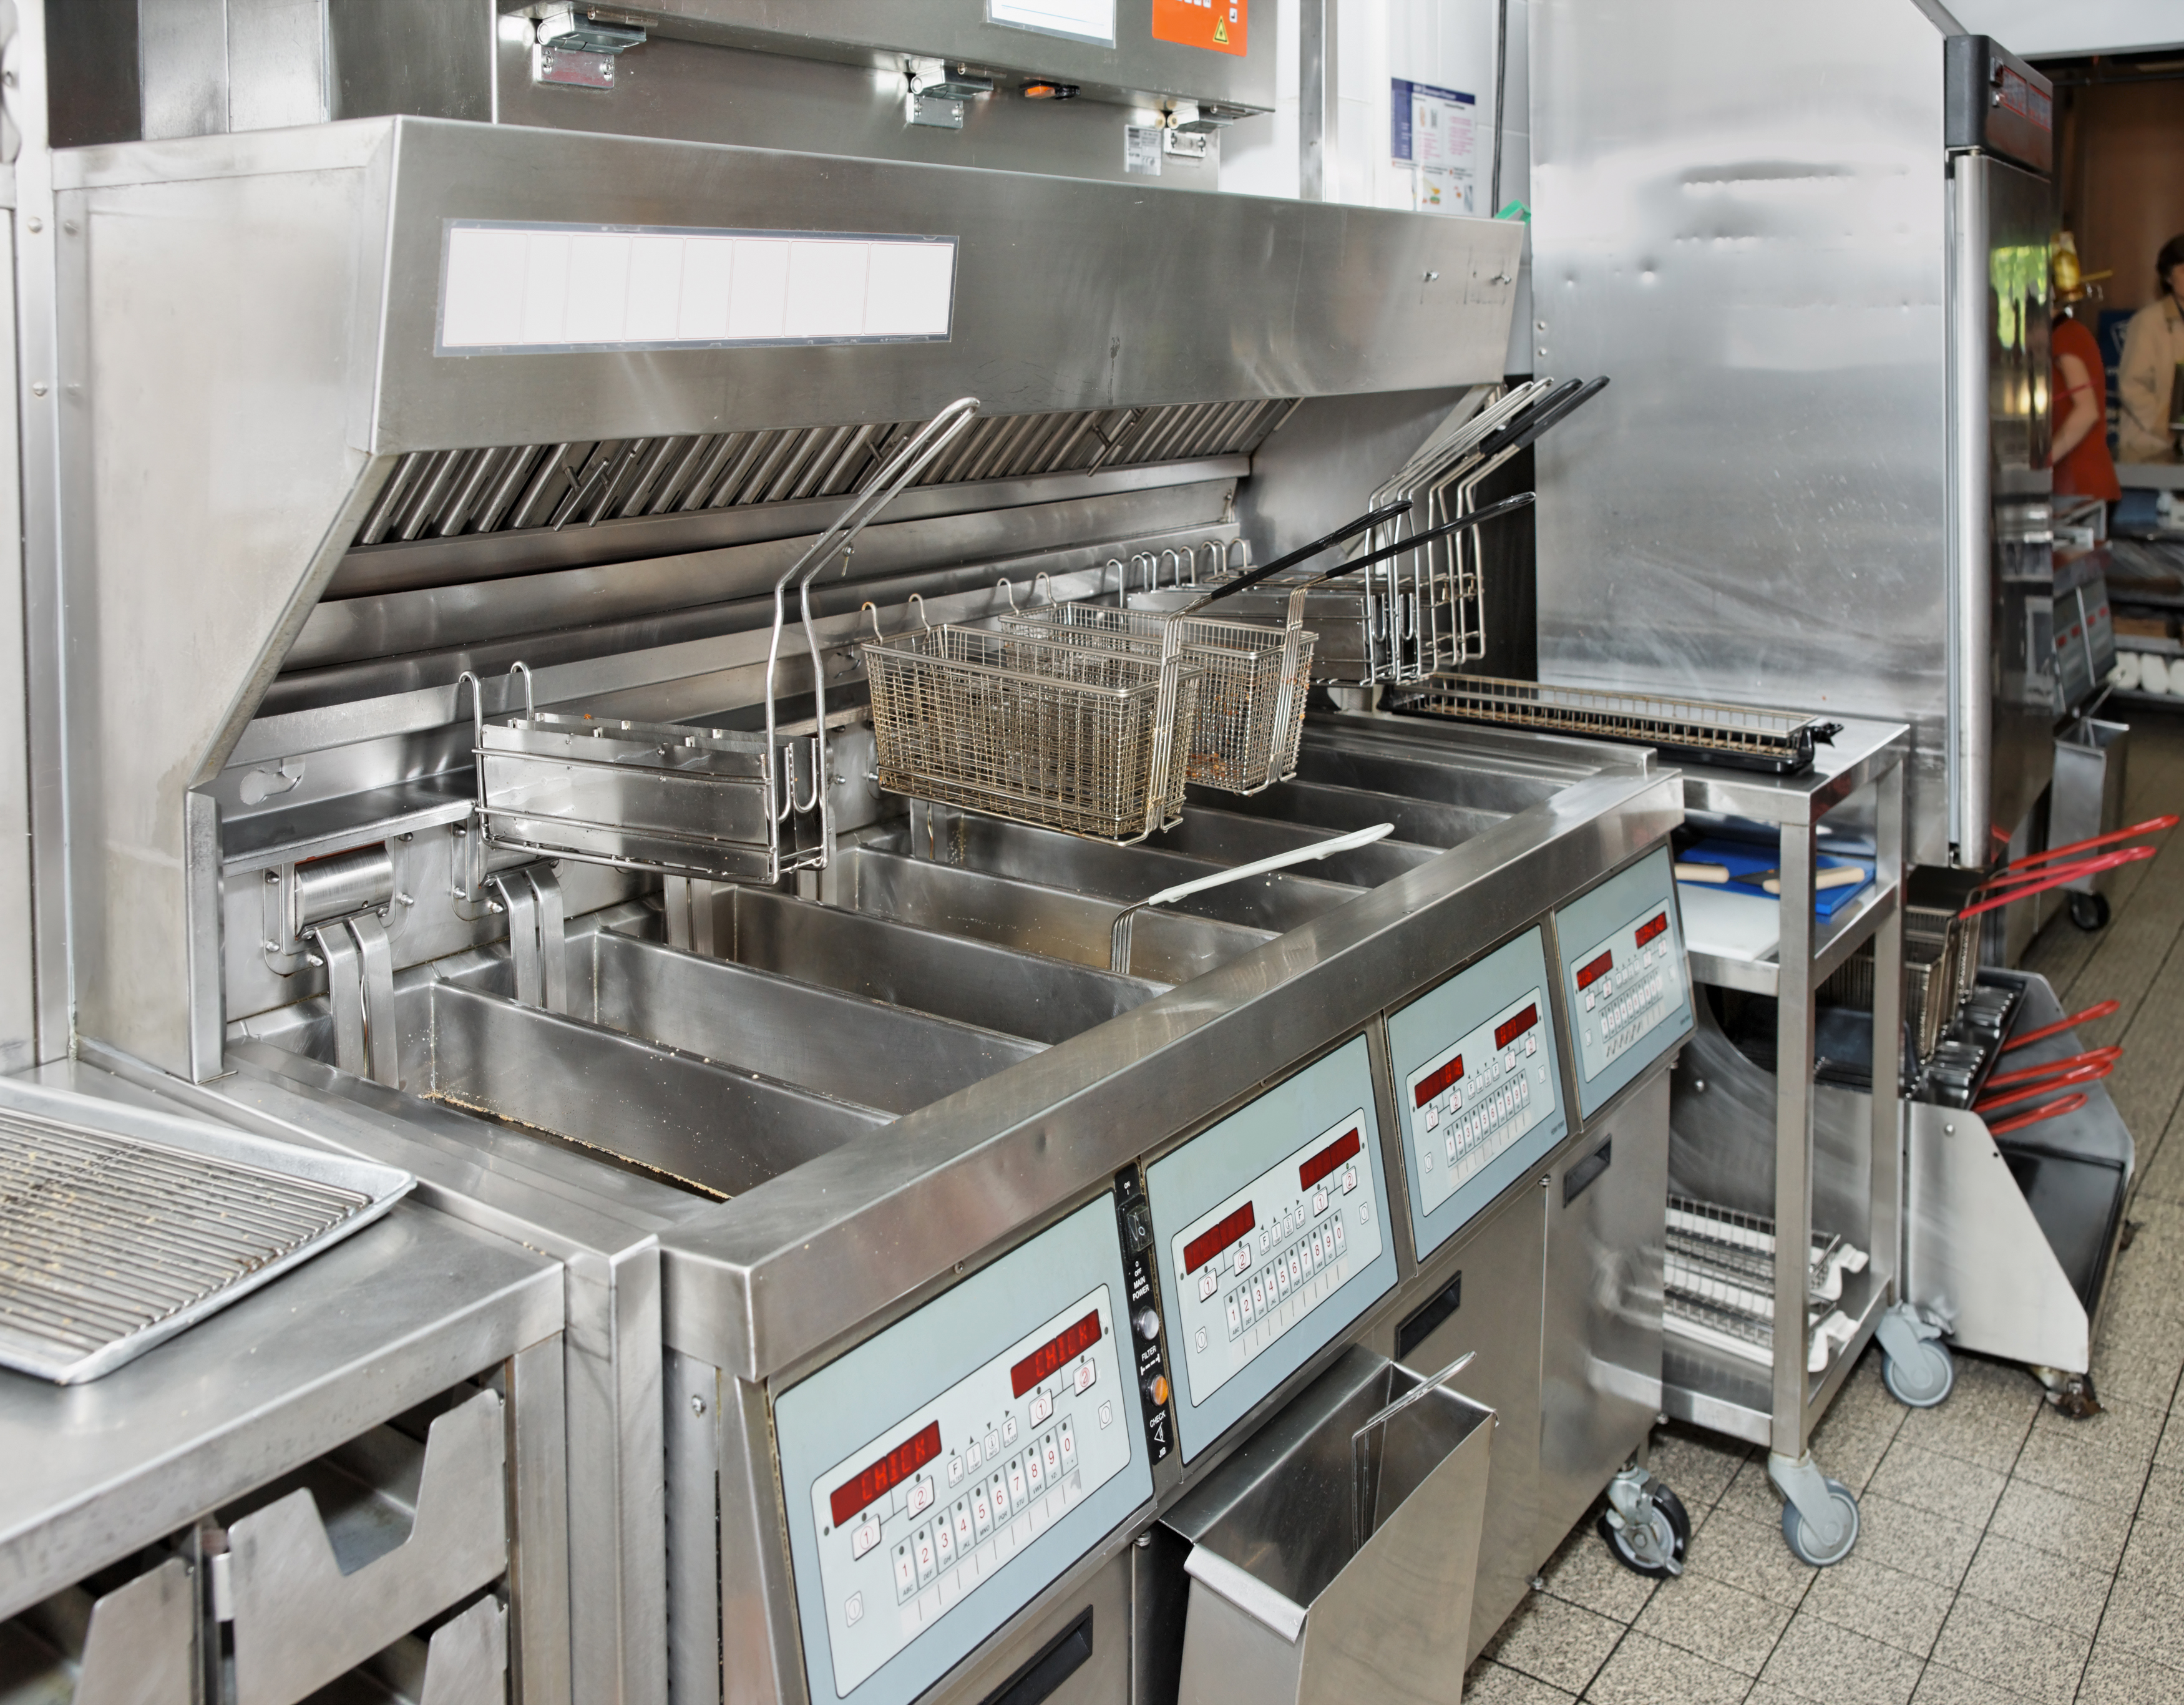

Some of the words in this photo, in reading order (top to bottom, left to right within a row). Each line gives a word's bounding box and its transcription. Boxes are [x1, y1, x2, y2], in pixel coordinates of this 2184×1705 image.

[1124, 1180, 1131, 1190] ON
[1262, 1236, 1266, 1246] F
[1298, 1209, 1302, 1220] F
[1133, 1275, 1146, 1290] MAIN
[1134, 1267, 1142, 1278] OFF
[1231, 1309, 1236, 1321] 1
[1244, 1299, 1249, 1312] 2
[1256, 1289, 1262, 1302] 3
[1269, 1280, 1274, 1291] 4
[1280, 1271, 1285, 1283] 5
[1292, 1262, 1297, 1274] 6
[1303, 1253, 1307, 1265] 7
[1315, 1244, 1320, 1256] 8
[1326, 1236, 1331, 1248] 9
[1337, 1227, 1342, 1239] 0
[1132, 1284, 1150, 1302] POWER
[1232, 1326, 1240, 1336] ABC
[1141, 1345, 1157, 1362] FILTER
[1149, 1409, 1166, 1429] CHECK
[953, 1462, 958, 1475] F
[1007, 1422, 1012, 1435] F
[1158, 1446, 1166, 1458] JIB
[860, 1437, 925, 1501] CHICK
[950, 1473, 963, 1485] FILTER
[970, 1460, 980, 1471] TEMP
[988, 1448, 998, 1457] INFO
[1004, 1433, 1016, 1445] FILTER
[902, 1563, 907, 1577] 1
[922, 1547, 929, 1564] 2
[941, 1533, 948, 1548] 3
[960, 1518, 967, 1532] 4
[978, 1503, 985, 1519] 5
[996, 1490, 1003, 1505] 6
[1013, 1475, 1020, 1492] 7
[1031, 1463, 1038, 1478] 8
[1048, 1450, 1055, 1465] 9
[1065, 1437, 1071, 1452] 0
[902, 1584, 914, 1596] ABC
[923, 1568, 933, 1581] DEF
[943, 1554, 952, 1565] GHI
[962, 1540, 971, 1551] JKL
[980, 1524, 990, 1536] MNO
[998, 1510, 1008, 1522] PQR
[1016, 1497, 1025, 1508] STU
[1033, 1483, 1042, 1494] VWX
